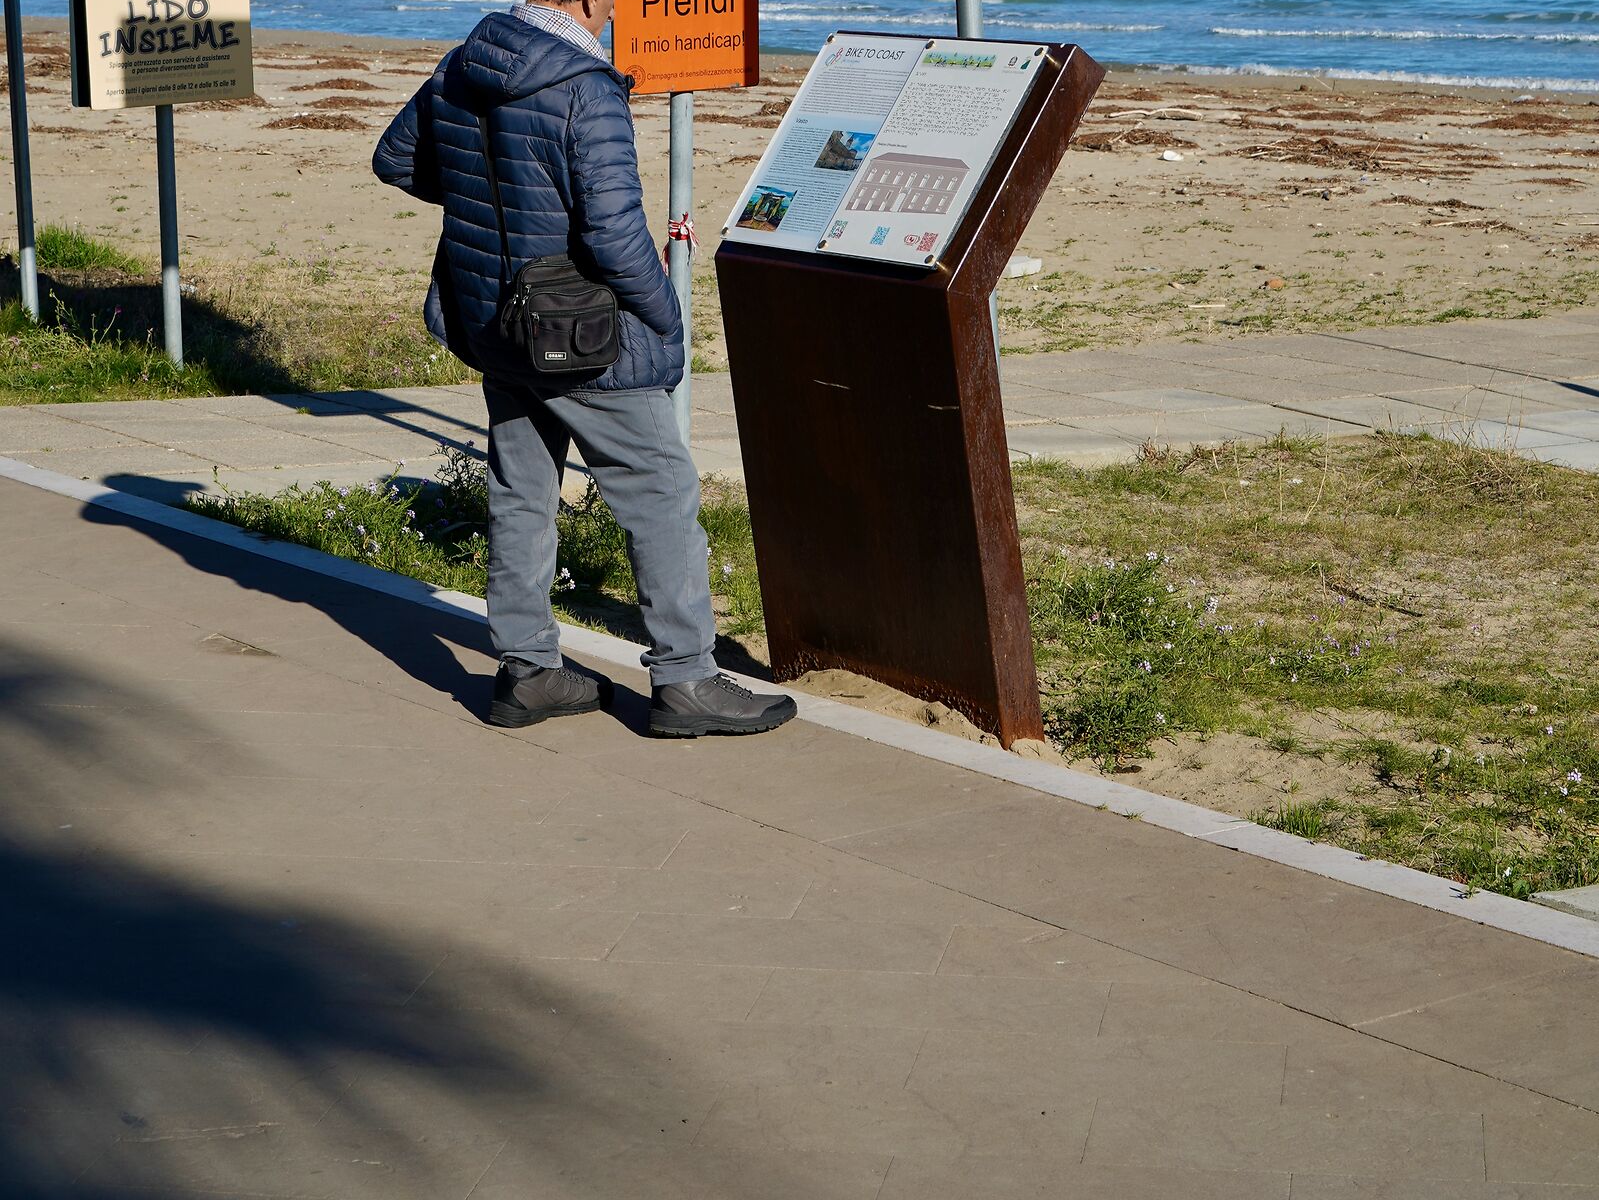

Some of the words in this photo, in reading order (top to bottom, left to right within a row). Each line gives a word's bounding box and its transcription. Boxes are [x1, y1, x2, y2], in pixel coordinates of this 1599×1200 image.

[99, 19, 240, 57] INSIEME
[631, 38, 638, 54] il
[644, 37, 670, 53] mio
[675, 30, 746, 52] handicap!
[845, 48, 864, 58] BIKE
[864, 49, 876, 58] TO
[876, 50, 906, 60] COAST
[647, 71, 677, 80] Campagna
[686, 69, 732, 78] sensibilizzazione
